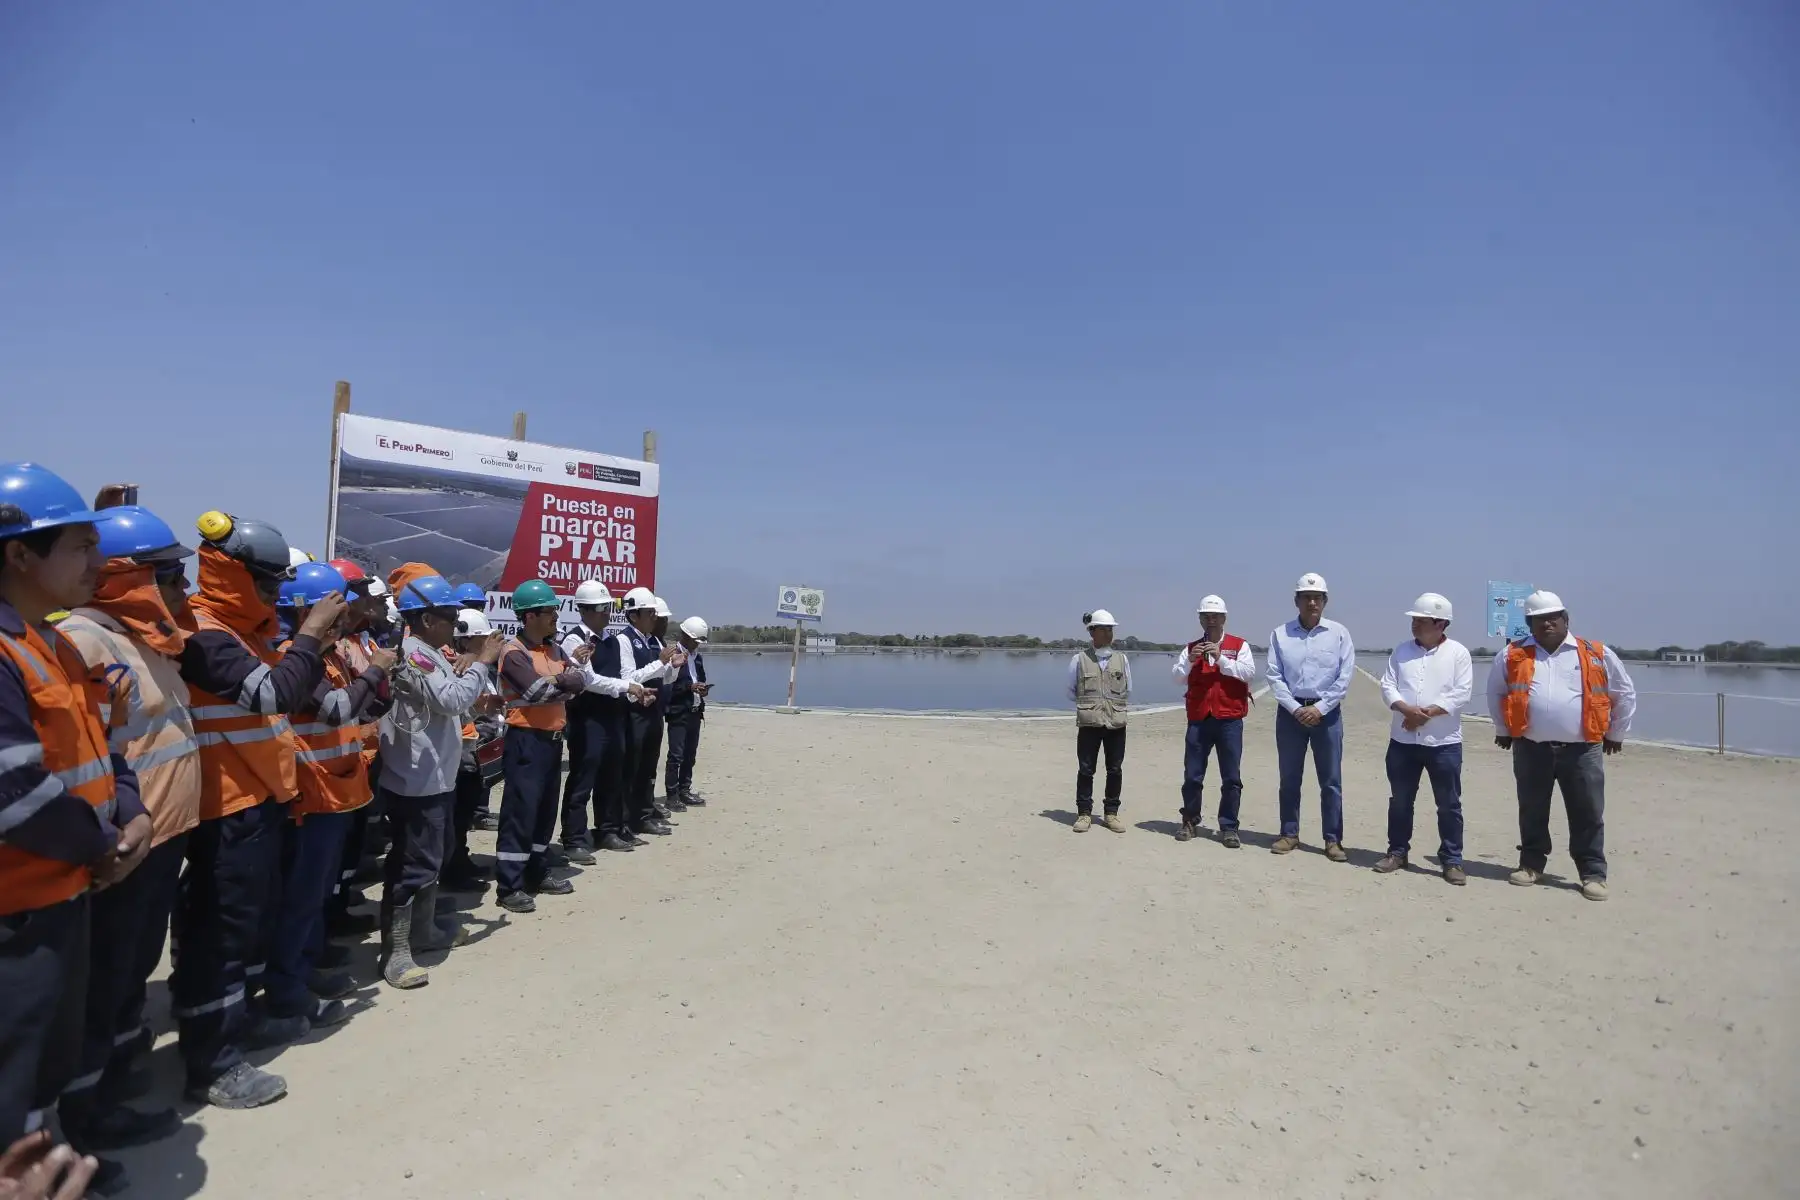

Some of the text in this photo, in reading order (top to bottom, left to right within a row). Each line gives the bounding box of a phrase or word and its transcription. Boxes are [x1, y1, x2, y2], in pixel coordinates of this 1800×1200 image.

[379, 438, 450, 457] EL PERÚ PRIMERO
[480, 457, 513, 468] Gobierno
[527, 464, 543, 473] Perú
[543, 493, 635, 520] Puesta en
[541, 514, 635, 541] marcha
[540, 533, 636, 564] PTAR
[537, 559, 637, 585] SAN MARTÍN
